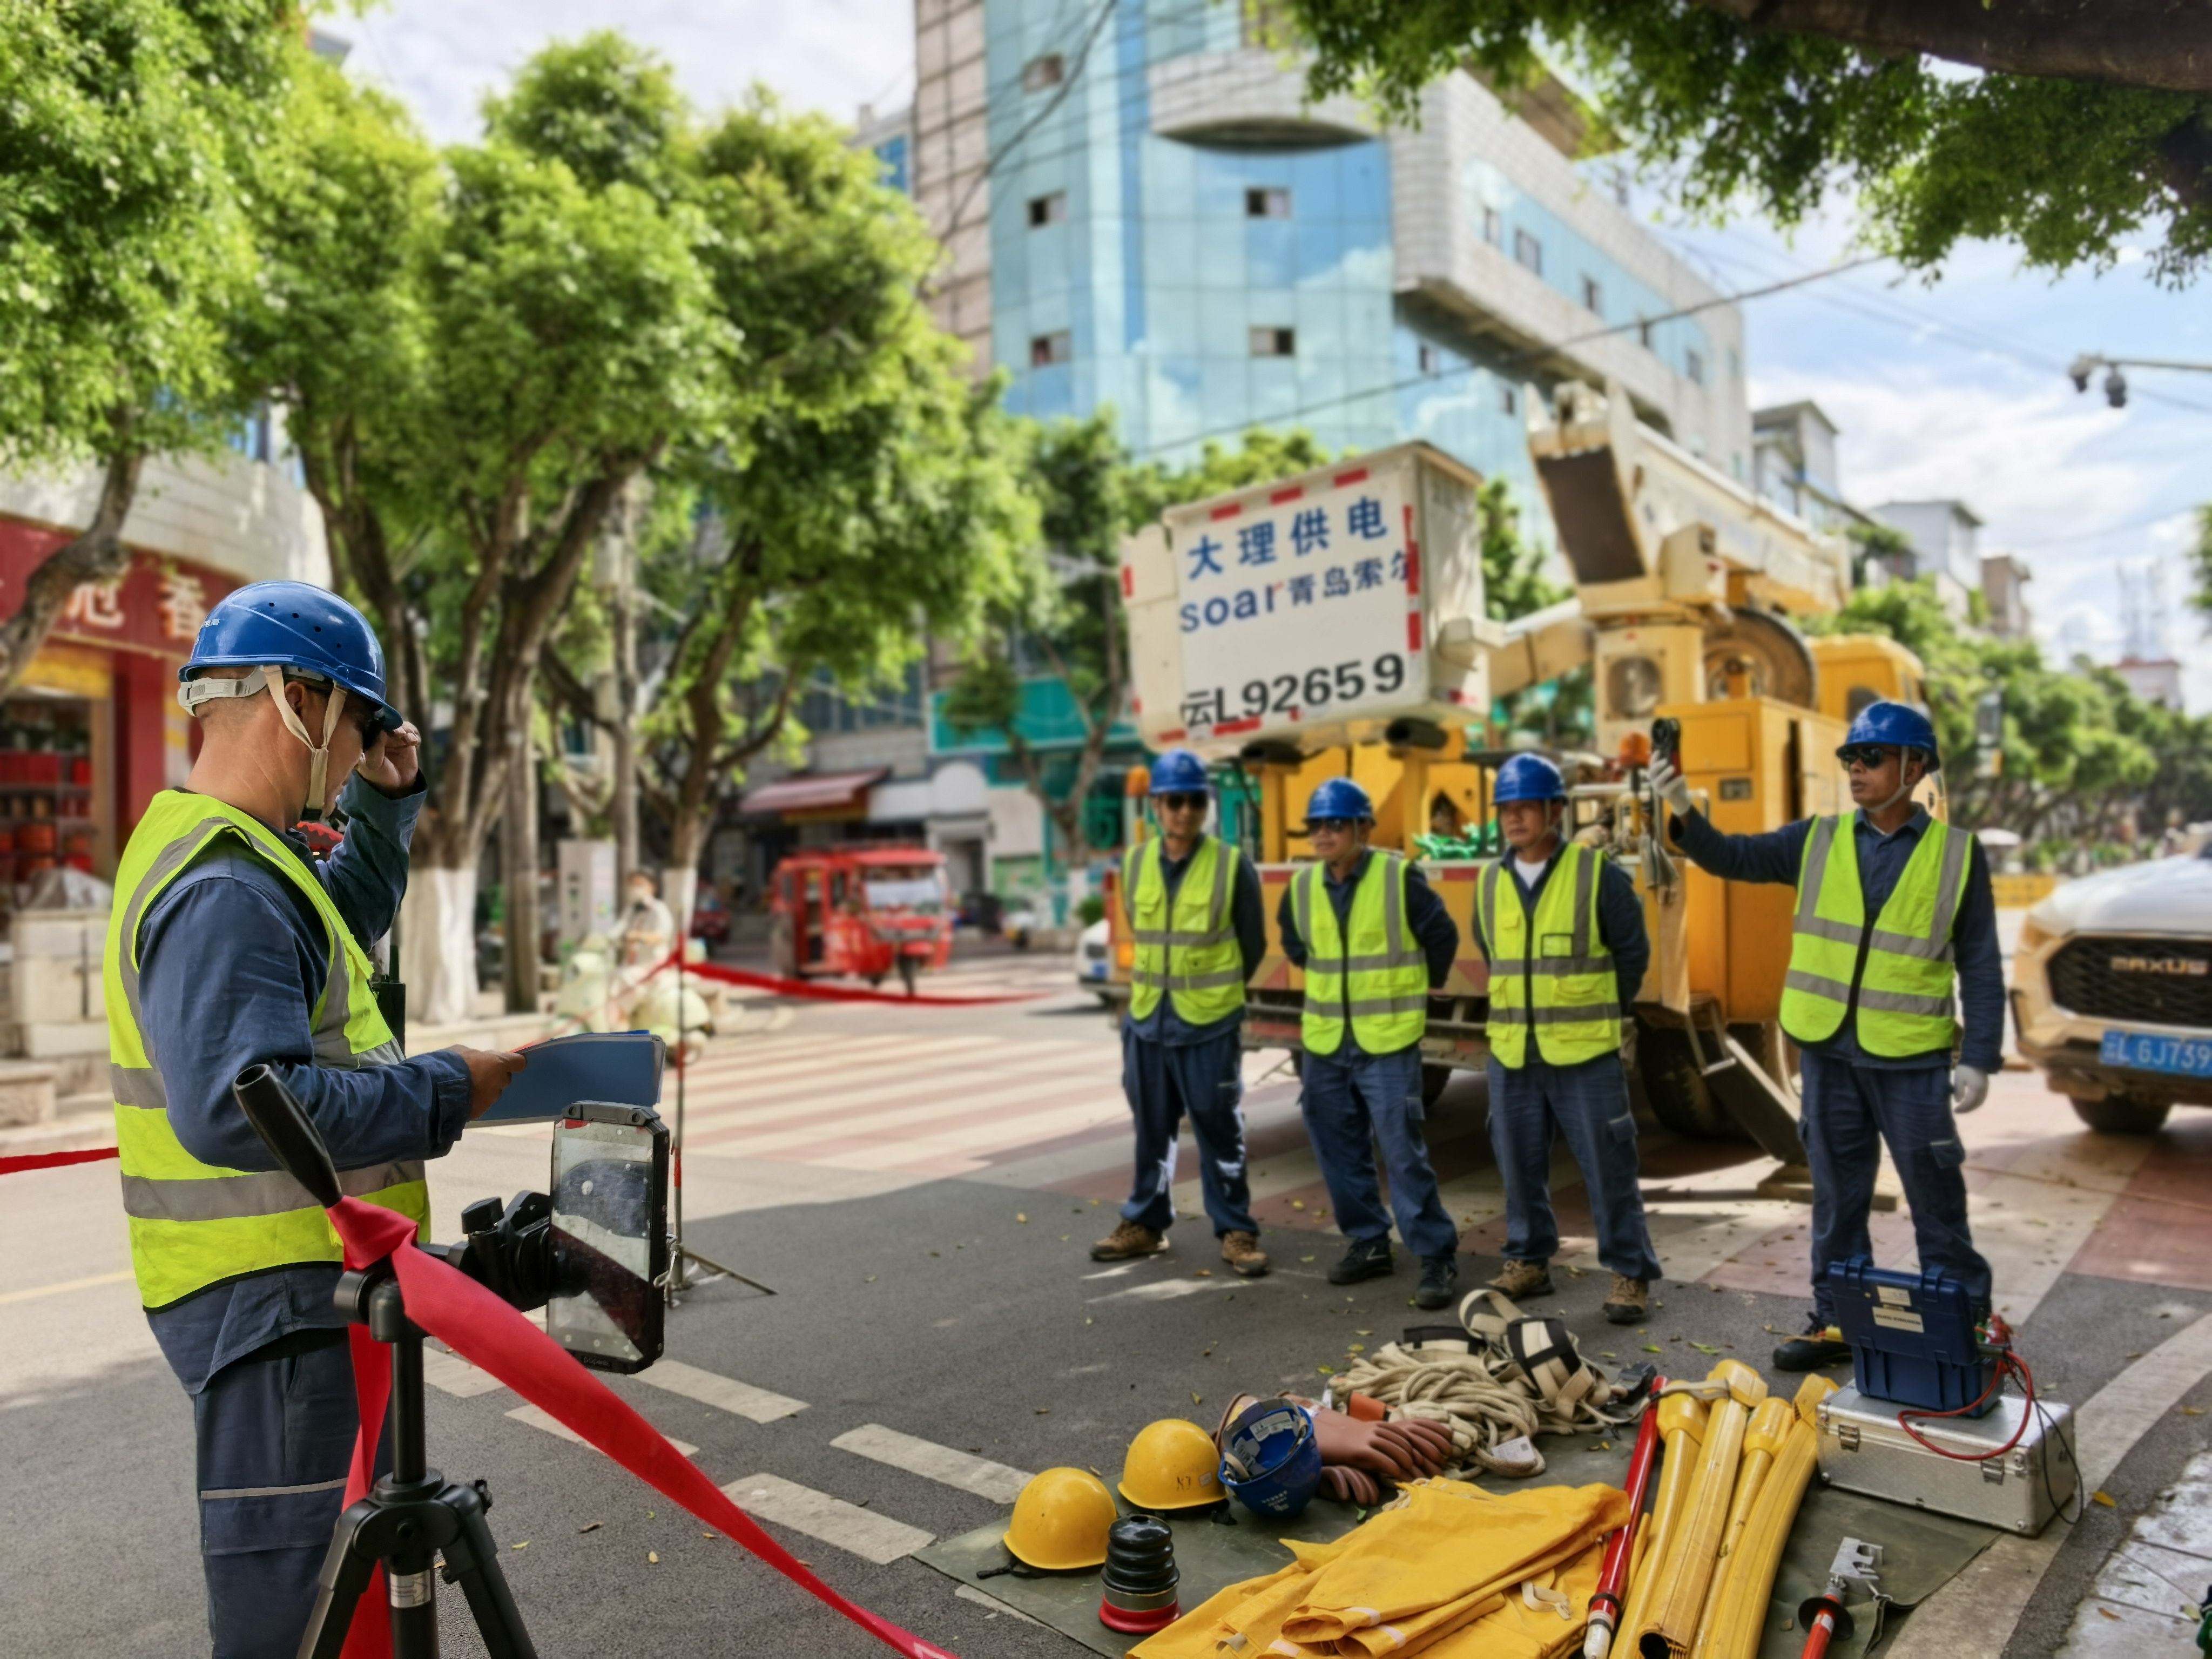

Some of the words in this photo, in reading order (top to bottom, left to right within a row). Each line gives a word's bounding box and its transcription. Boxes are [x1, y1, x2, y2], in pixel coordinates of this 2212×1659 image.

[1188, 496, 1388, 581] 大理供电
[1179, 653, 1405, 727] 云L92659
